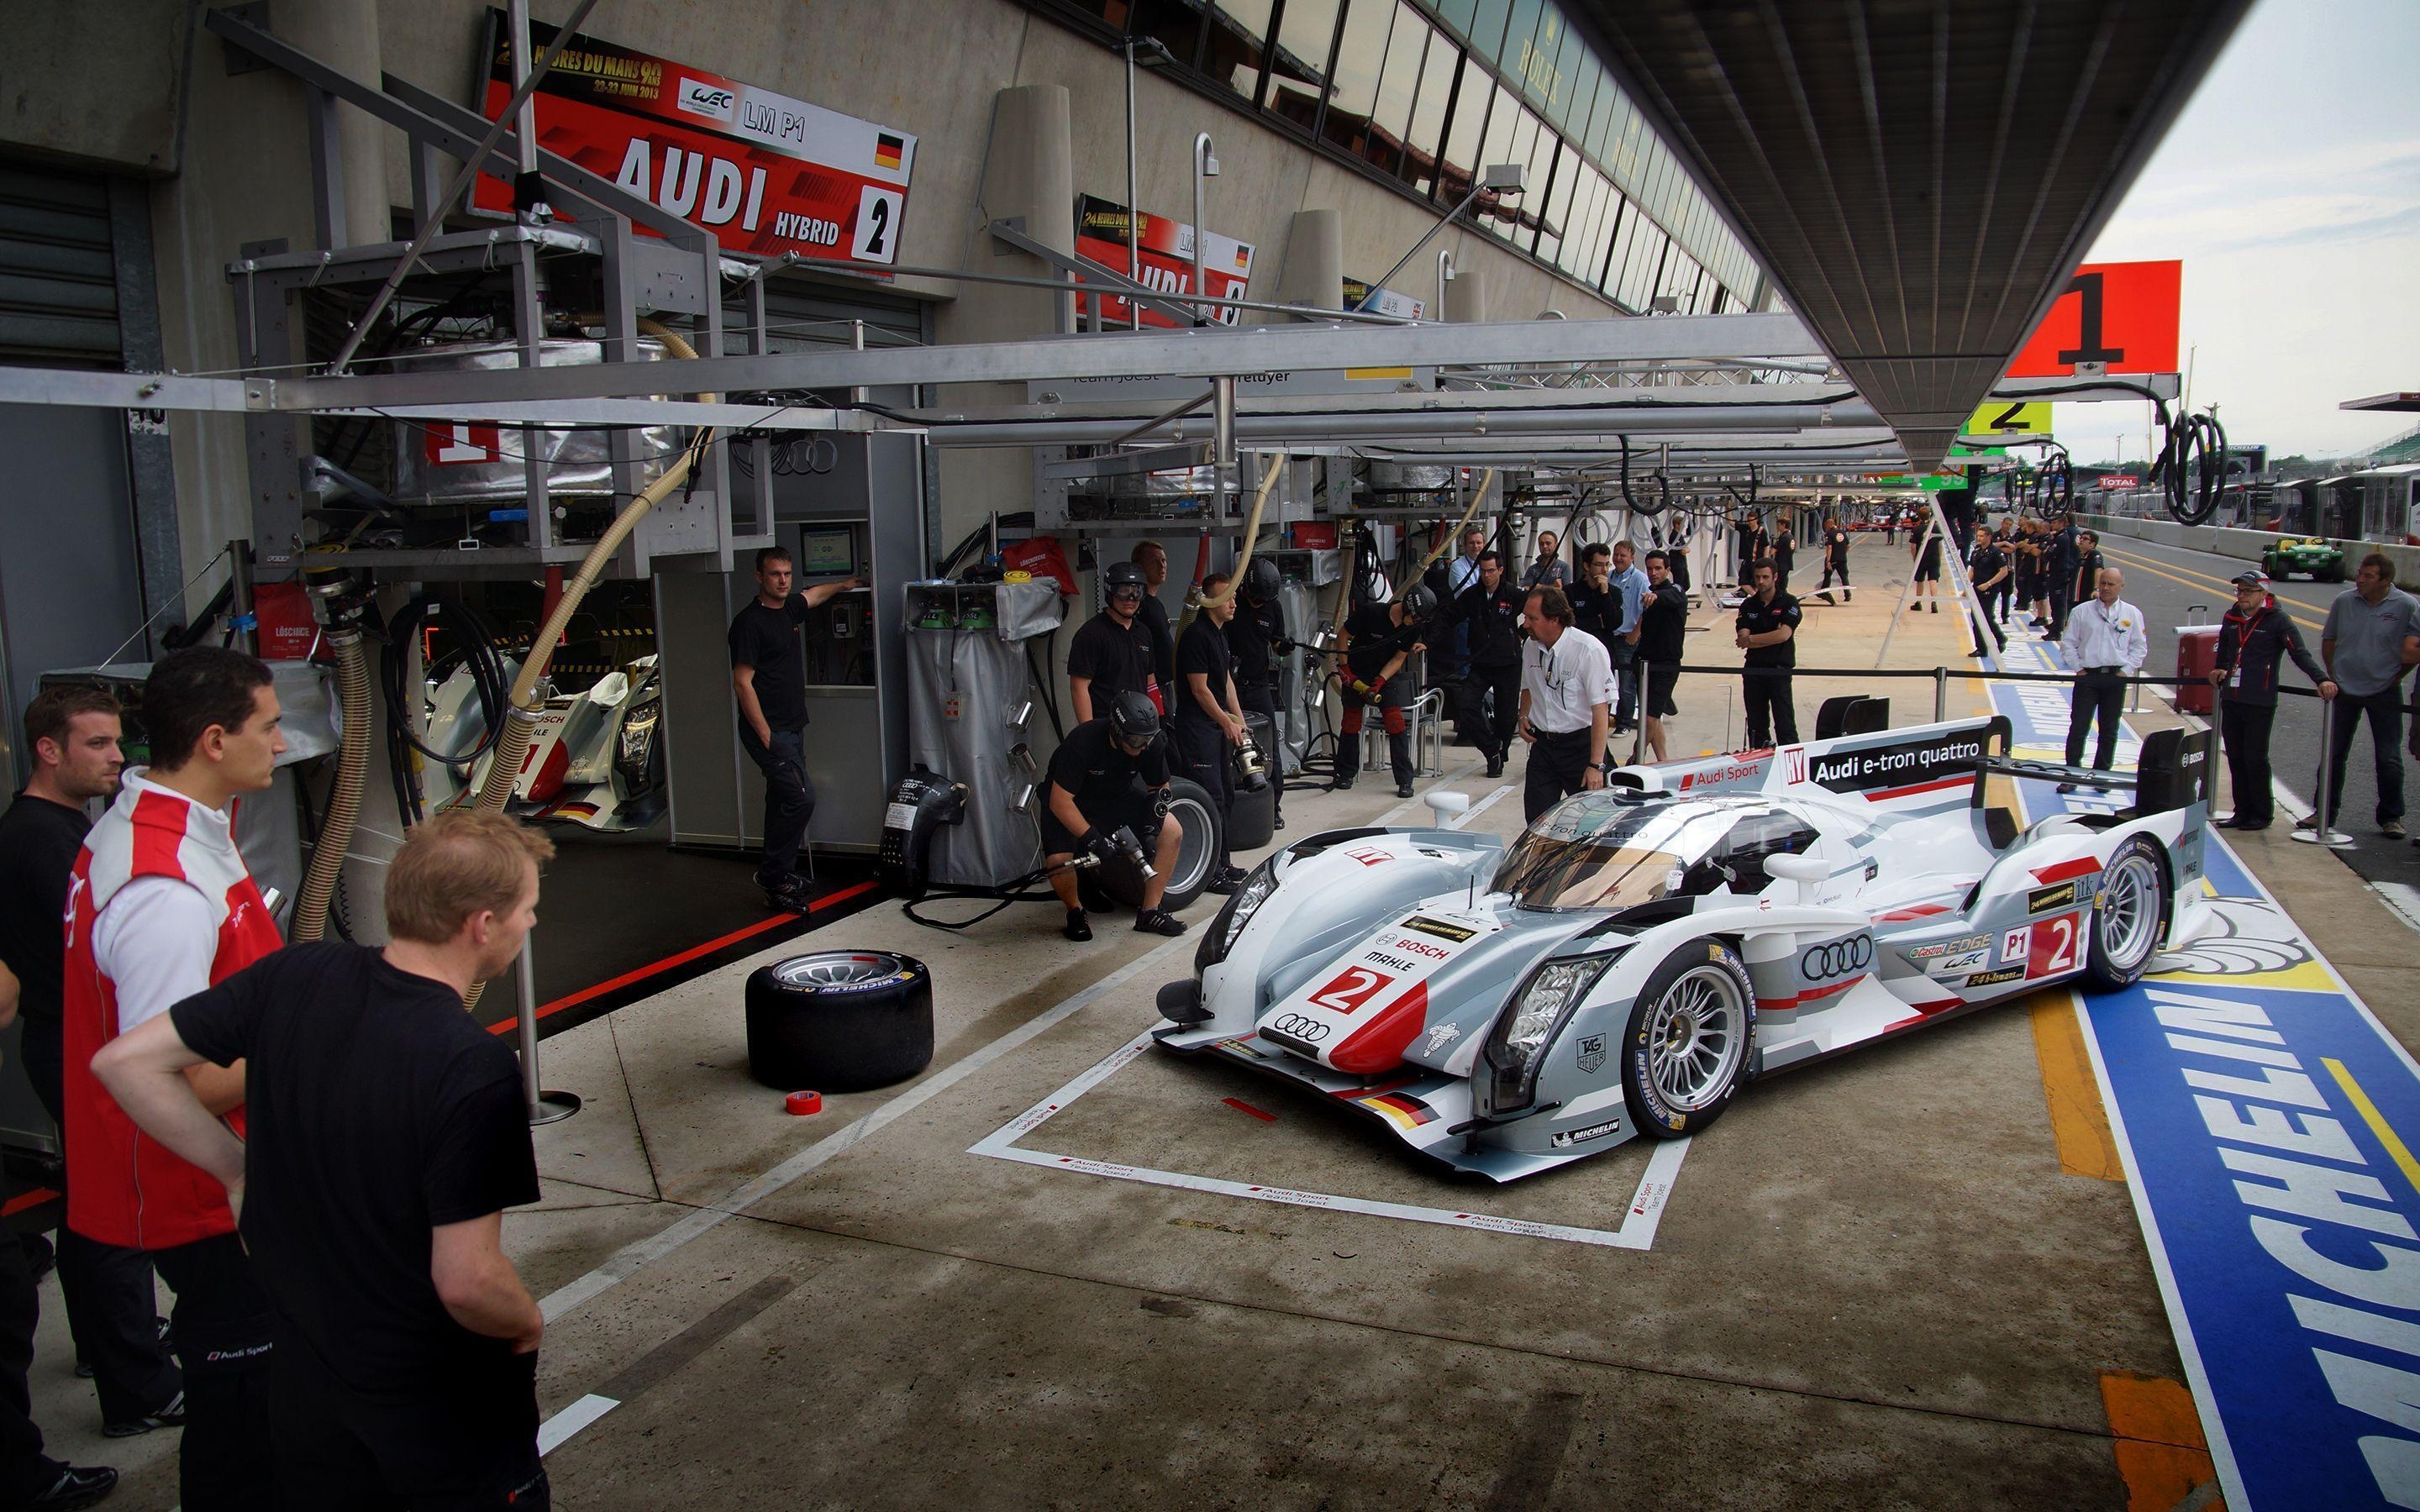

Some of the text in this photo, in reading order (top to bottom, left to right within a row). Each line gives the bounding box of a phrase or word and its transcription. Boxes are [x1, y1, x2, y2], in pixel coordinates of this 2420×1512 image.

[583, 53, 603, 73] DU
[603, 56, 640, 79] MANS
[1518, 38, 1562, 107] ROLEX
[619, 82, 638, 97] JUIN
[639, 86, 660, 100] 2013
[691, 87, 734, 109] WEC
[744, 101, 805, 143] LM P1
[615, 136, 767, 234] AUDI
[775, 211, 840, 248] HYBRID
[865, 197, 892, 255] 2
[2060, 272, 2124, 365] 1
[2101, 477, 2137, 488] TOTAL
[1815, 742, 1980, 783] Audi e-tron quattro
[2189, 751, 2204, 764] BOSCH
[1697, 764, 1759, 785] Audi Sport
[1541, 822, 1648, 839] e-tron quattro
[2103, 841, 2135, 885] MICHELIN
[1395, 939, 1450, 960] BOSCH
[1918, 945, 1944, 957] Castrol
[1947, 932, 1993, 955] EDGE
[2007, 932, 2026, 957] P1
[2049, 919, 2072, 970] 2
[1365, 952, 1416, 972] MAHLE
[1944, 953, 1984, 969] WEC
[823, 978, 895, 993] MICHELIN
[1318, 970, 1378, 1010] 2
[1728, 955, 1756, 1017] MICHELIN
[1642, 1003, 1652, 1032] MICHELIN
[1581, 1037, 1602, 1054] TAG
[1580, 1053, 1604, 1069] HEUER
[1636, 1053, 1665, 1119] MICHELIN
[1574, 1121, 1619, 1140] MICHELIN
[1102, 1164, 1134, 1173] Sport
[1297, 1193, 1330, 1201] Sport
[1641, 1183, 1654, 1196] Sport
[1470, 1221, 1504, 1229] Team
[1472, 1215, 1544, 1229] Audi Sport
[221, 1341, 273, 1359] Audi Sport
